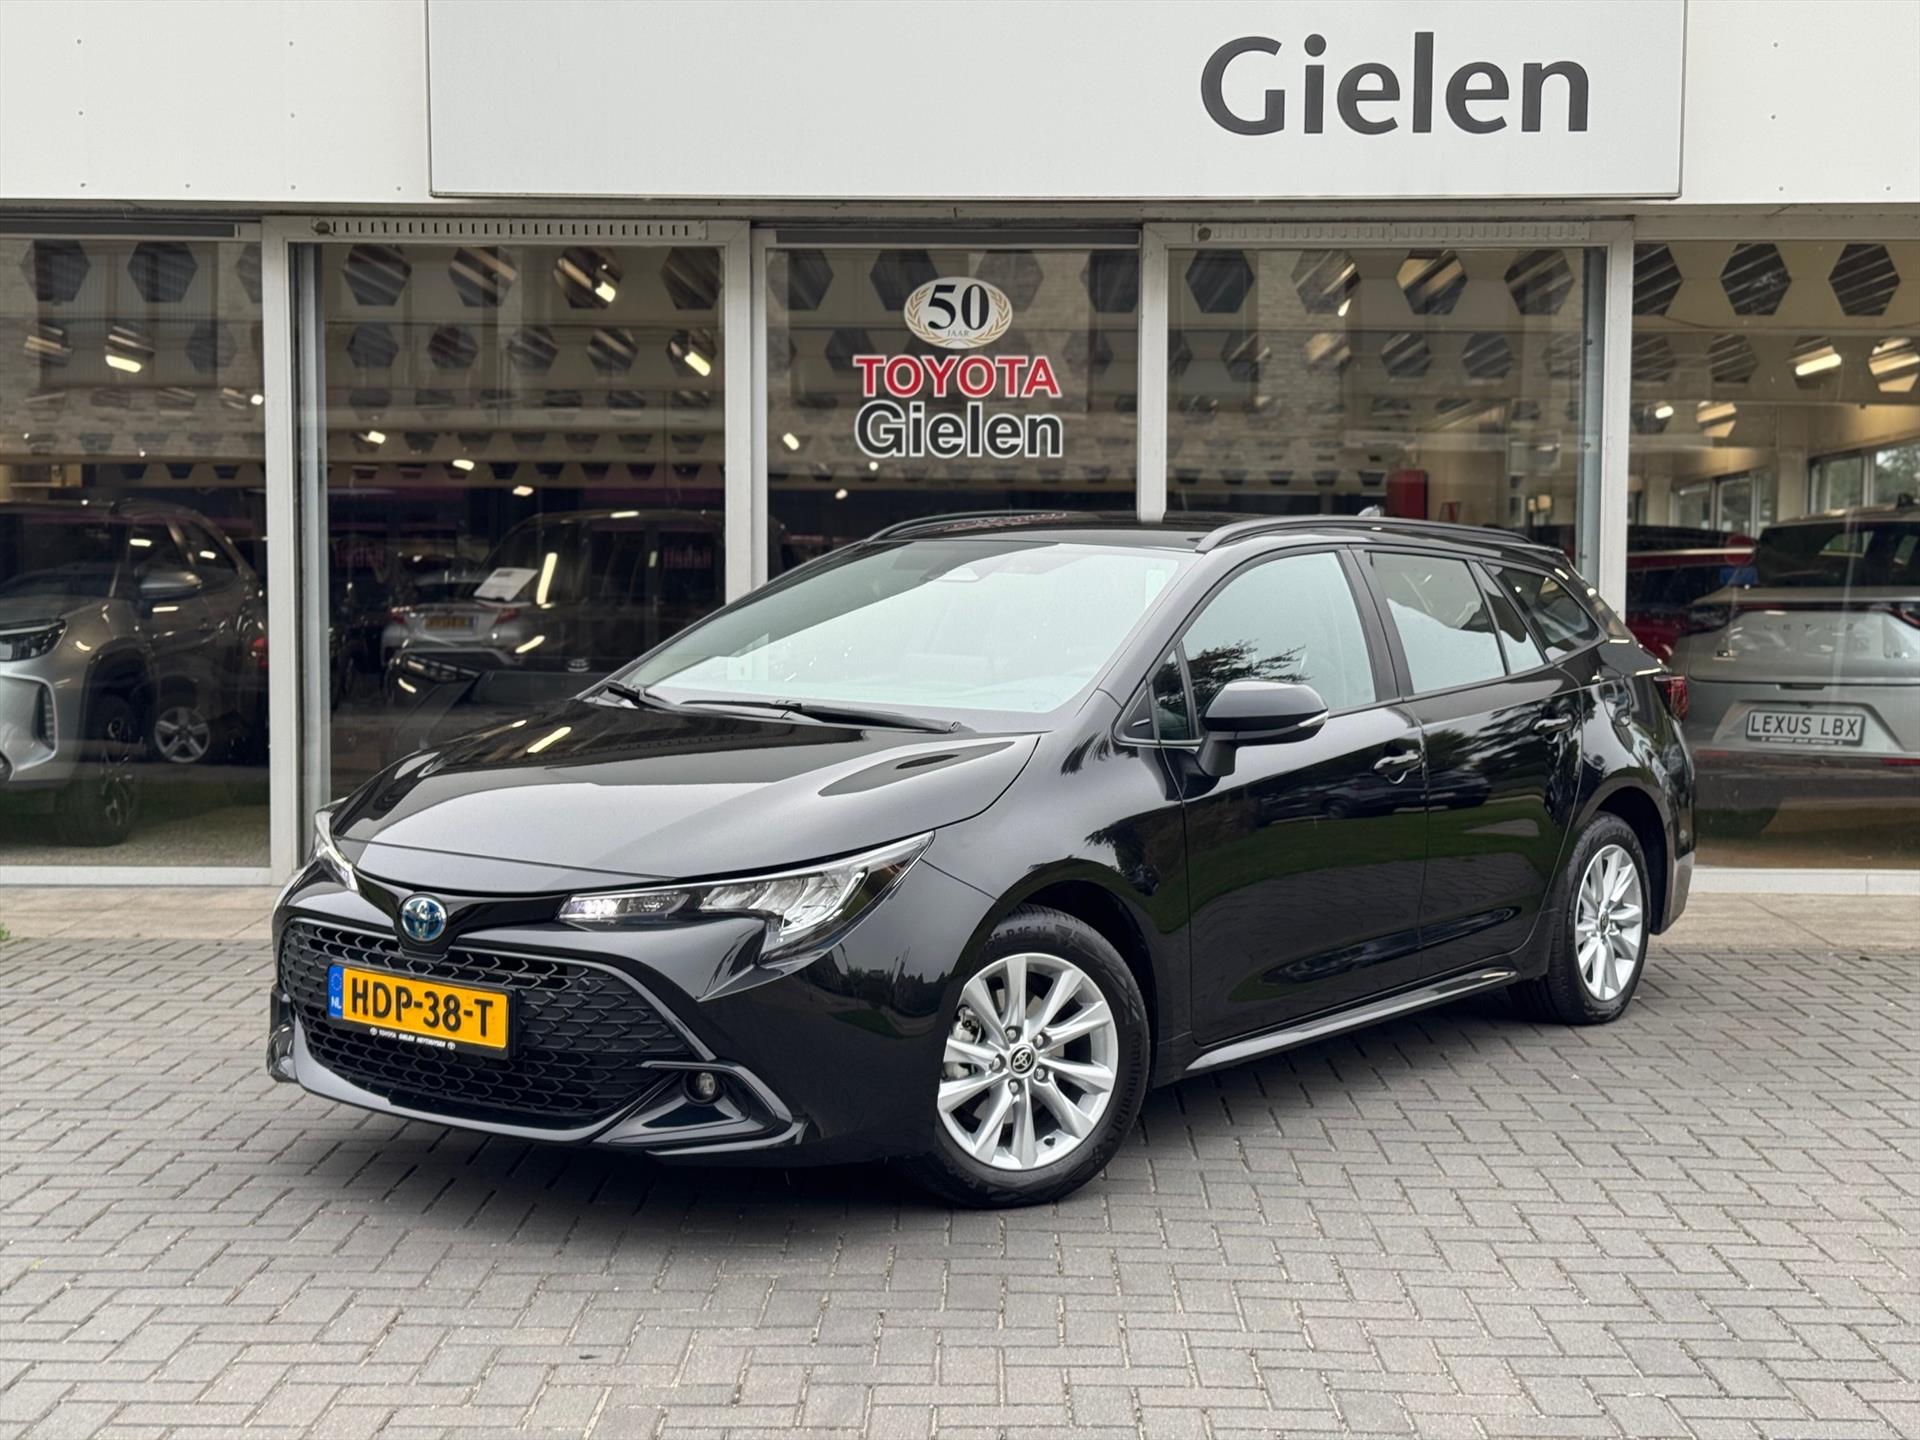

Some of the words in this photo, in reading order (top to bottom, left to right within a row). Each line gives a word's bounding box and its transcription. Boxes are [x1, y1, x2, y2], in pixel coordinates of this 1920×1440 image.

[1200, 31, 1589, 136] Gielen
[928, 284, 990, 330] 50
[947, 329, 970, 337] JAAR
[853, 355, 1062, 397] TOYOTA
[855, 400, 1063, 458] Gielen
[1751, 715, 1812, 735] LEXUS
[1820, 717, 1858, 738] LBX
[331, 996, 342, 1009] NL
[351, 977, 494, 1037] HDP-38-T
